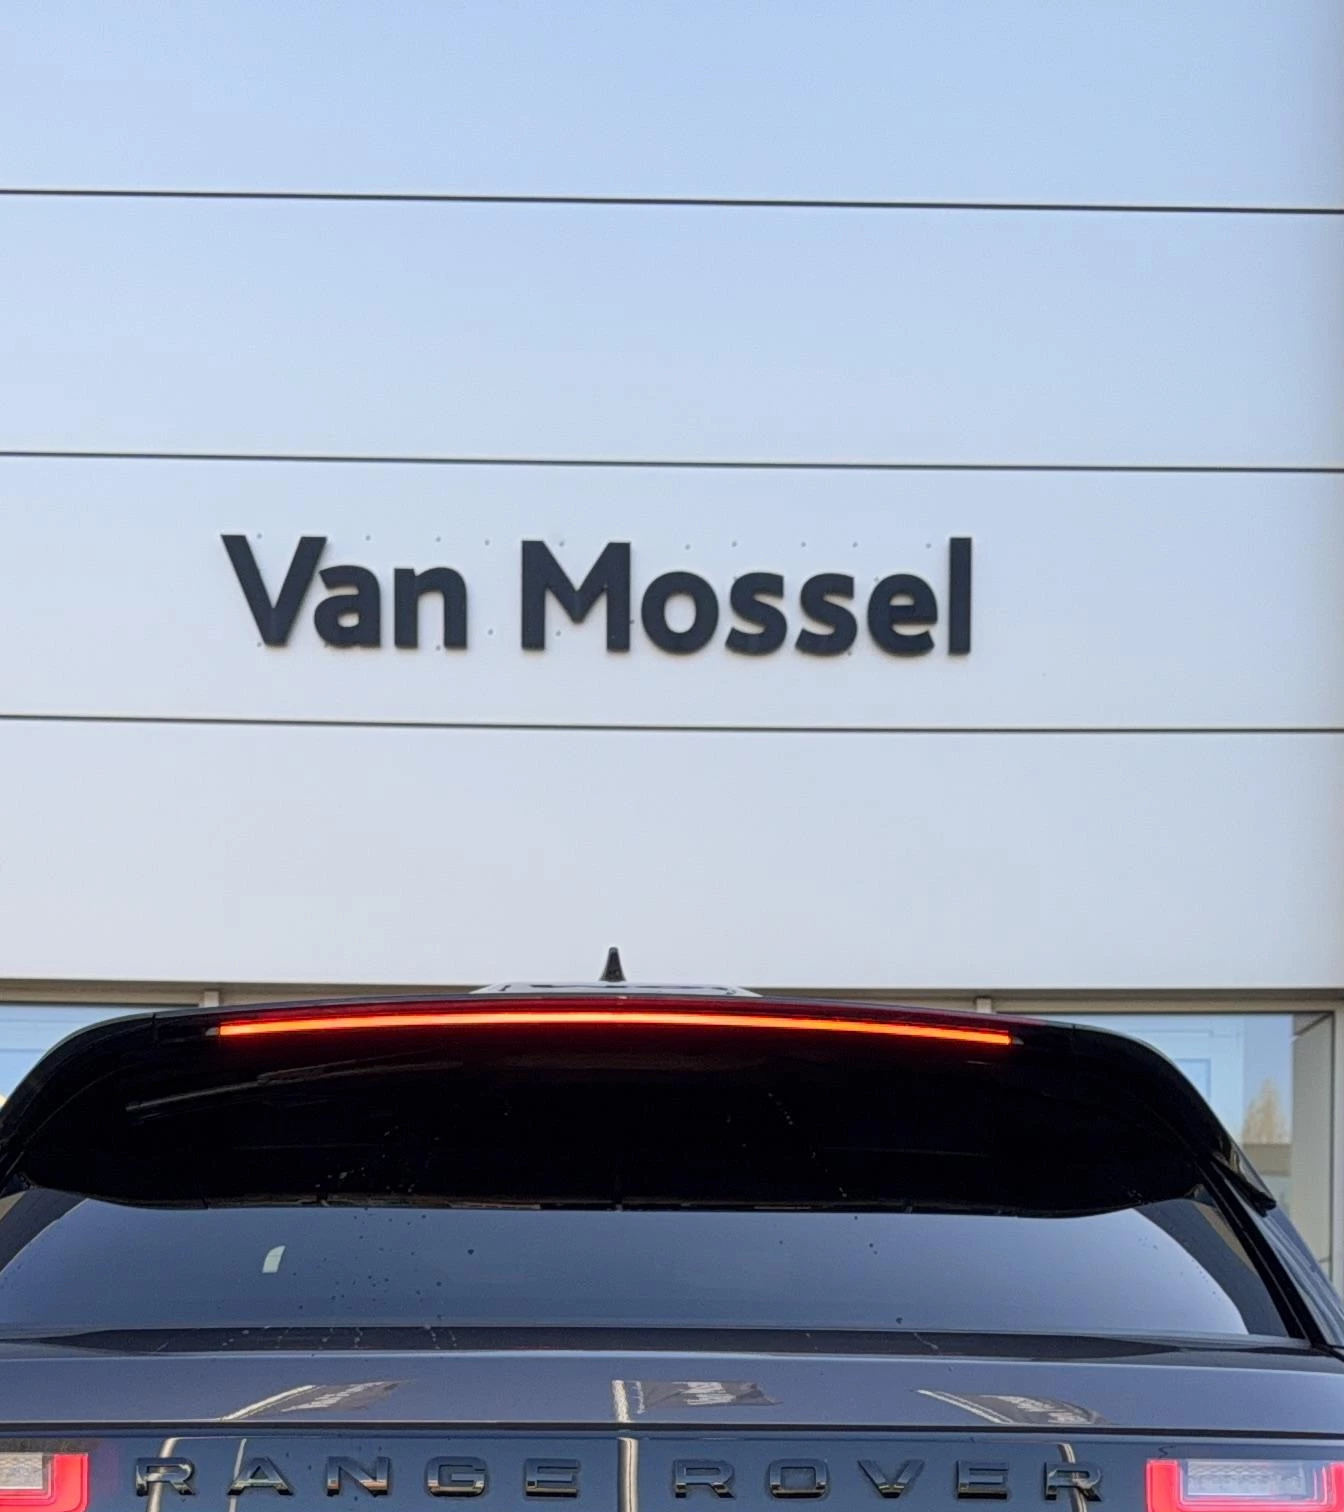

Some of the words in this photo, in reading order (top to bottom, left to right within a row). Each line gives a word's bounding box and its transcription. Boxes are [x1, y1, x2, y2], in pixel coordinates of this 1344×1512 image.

[220, 533, 469, 650] Van
[520, 536, 973, 657] Mossel
[134, 1456, 582, 1499] RANGE
[671, 1458, 1103, 1502] ROVER
